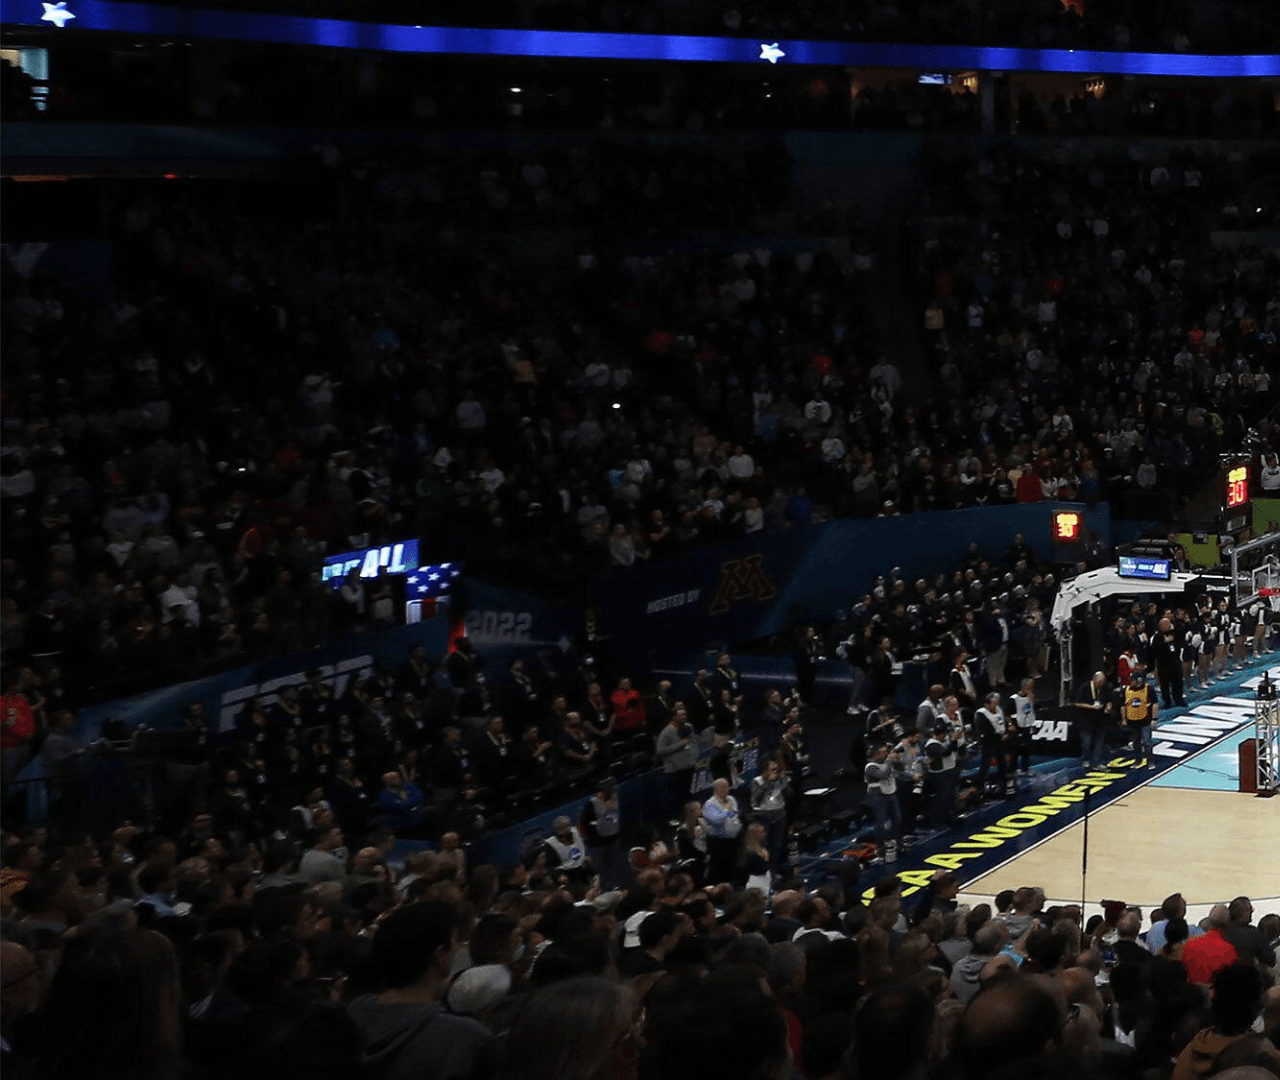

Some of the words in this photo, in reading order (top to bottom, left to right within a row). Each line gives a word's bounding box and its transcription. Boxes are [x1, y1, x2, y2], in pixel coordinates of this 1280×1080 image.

[646, 592, 686, 615] HOSTED
[686, 588, 701, 604] BY
[464, 609, 534, 638] 2022
[1030, 720, 1069, 742] CAA
